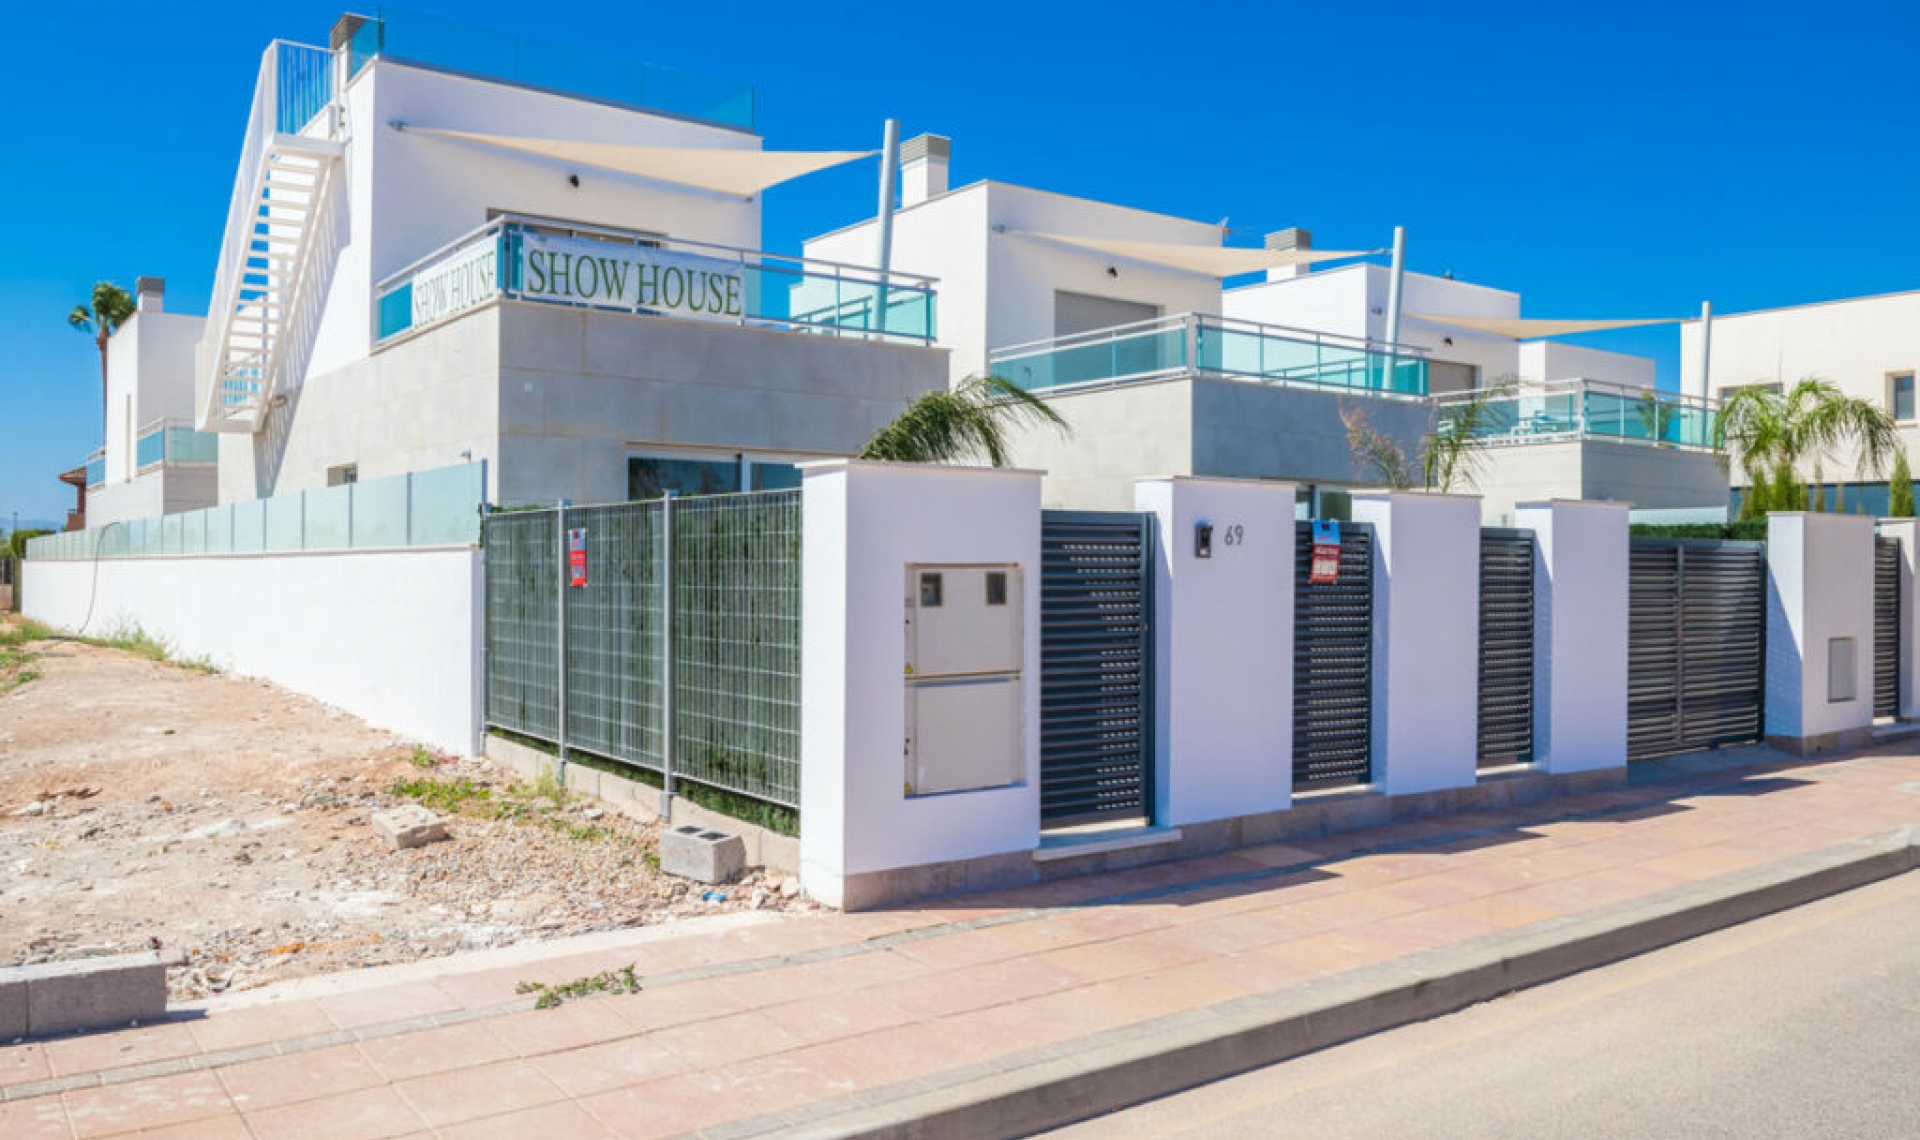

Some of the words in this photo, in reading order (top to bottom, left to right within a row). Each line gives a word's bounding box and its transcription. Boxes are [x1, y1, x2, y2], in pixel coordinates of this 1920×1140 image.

[414, 273, 448, 329] SHOW
[449, 250, 494, 313] HOUSE
[529, 249, 629, 301] SHOW
[636, 262, 741, 316] HOUSE
[1224, 524, 1244, 545] 69
